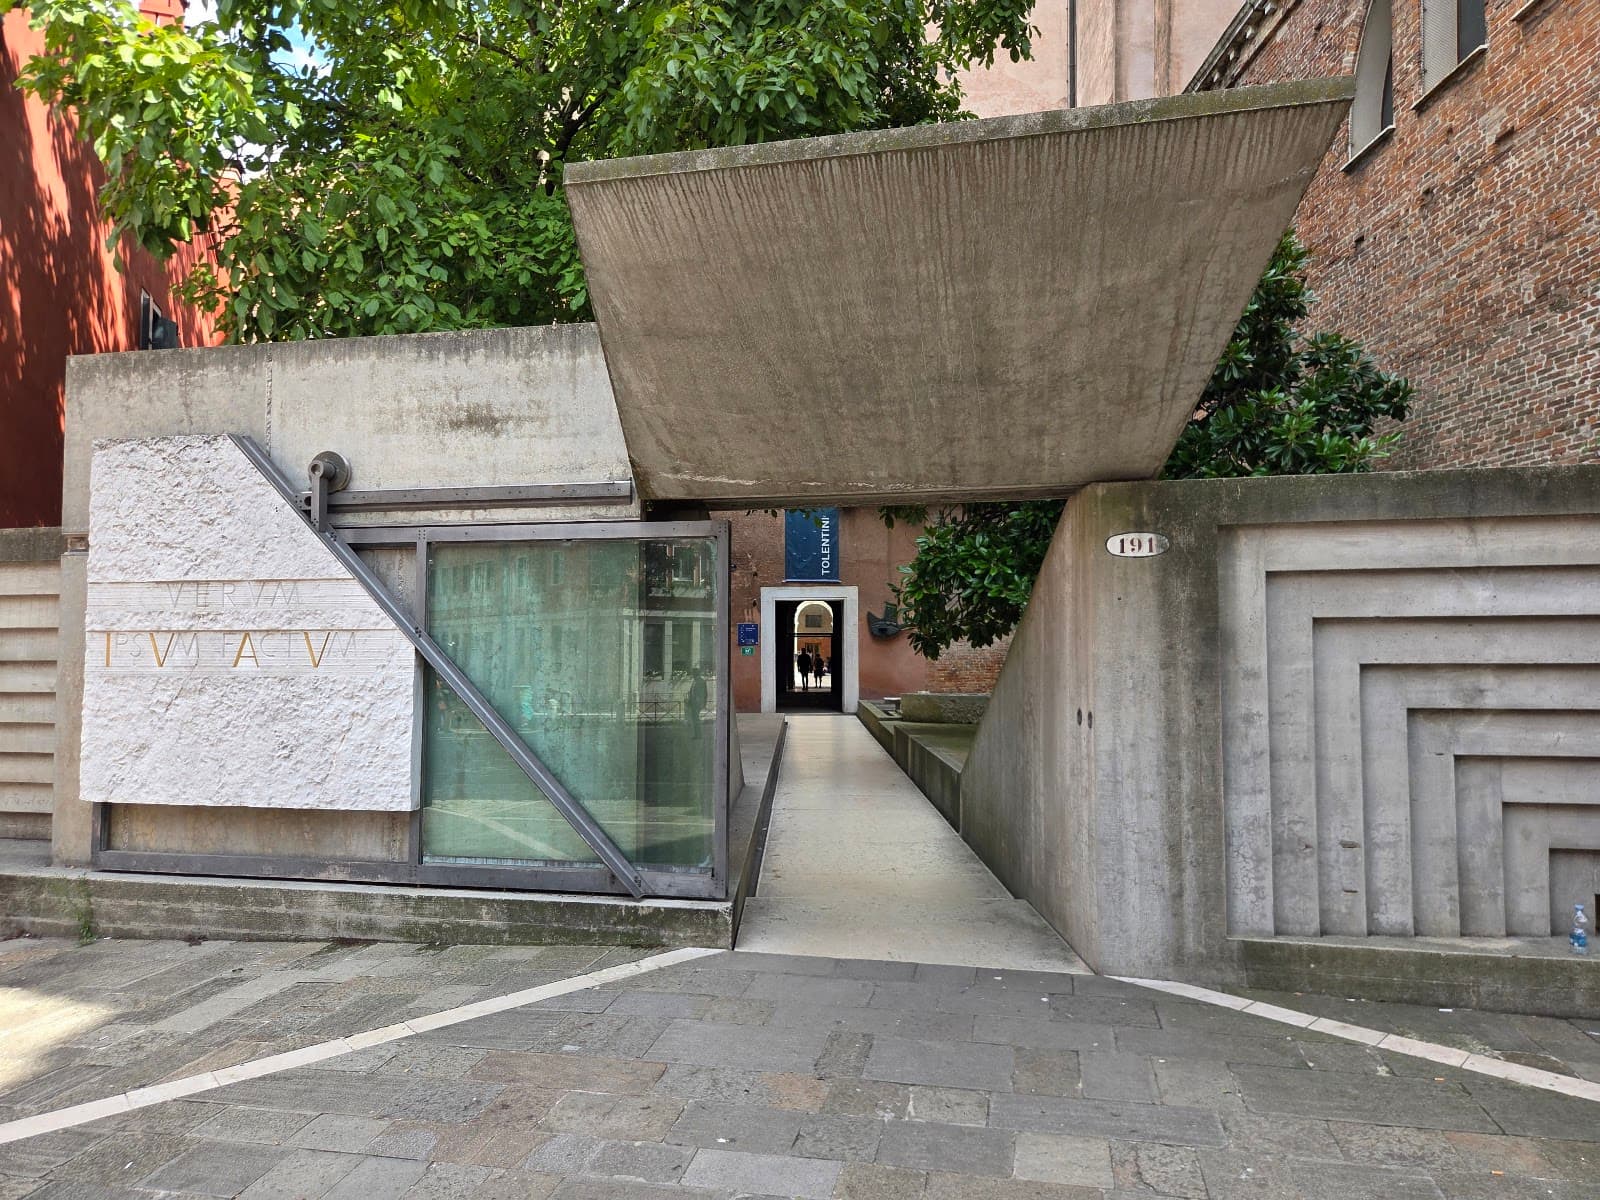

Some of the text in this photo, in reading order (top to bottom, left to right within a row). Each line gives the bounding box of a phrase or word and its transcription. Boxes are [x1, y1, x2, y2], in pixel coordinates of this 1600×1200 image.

[821, 516, 831, 577] TOLENTINI
[1119, 536, 1154, 554] 191
[166, 581, 300, 608] VERVM
[105, 631, 357, 668] IPSVM FACTVM
